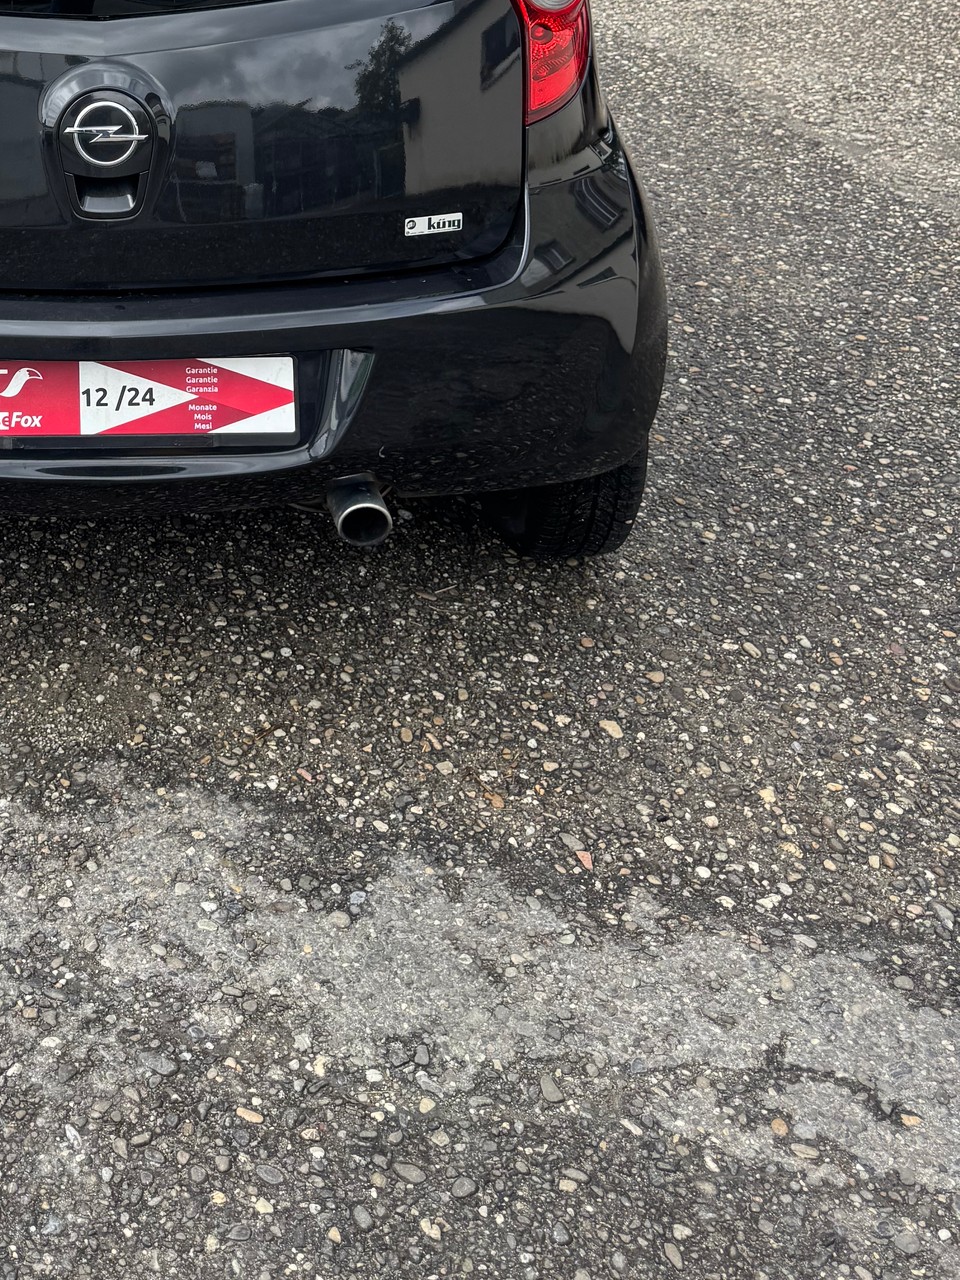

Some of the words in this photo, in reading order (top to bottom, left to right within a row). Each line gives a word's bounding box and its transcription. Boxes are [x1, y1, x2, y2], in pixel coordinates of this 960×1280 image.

[185, 366, 218, 374] Garantie
[185, 385, 219, 393] Garanzia
[81, 388, 108, 407] 12
[115, 385, 155, 411] /24
[194, 422, 213, 430] Mesi
